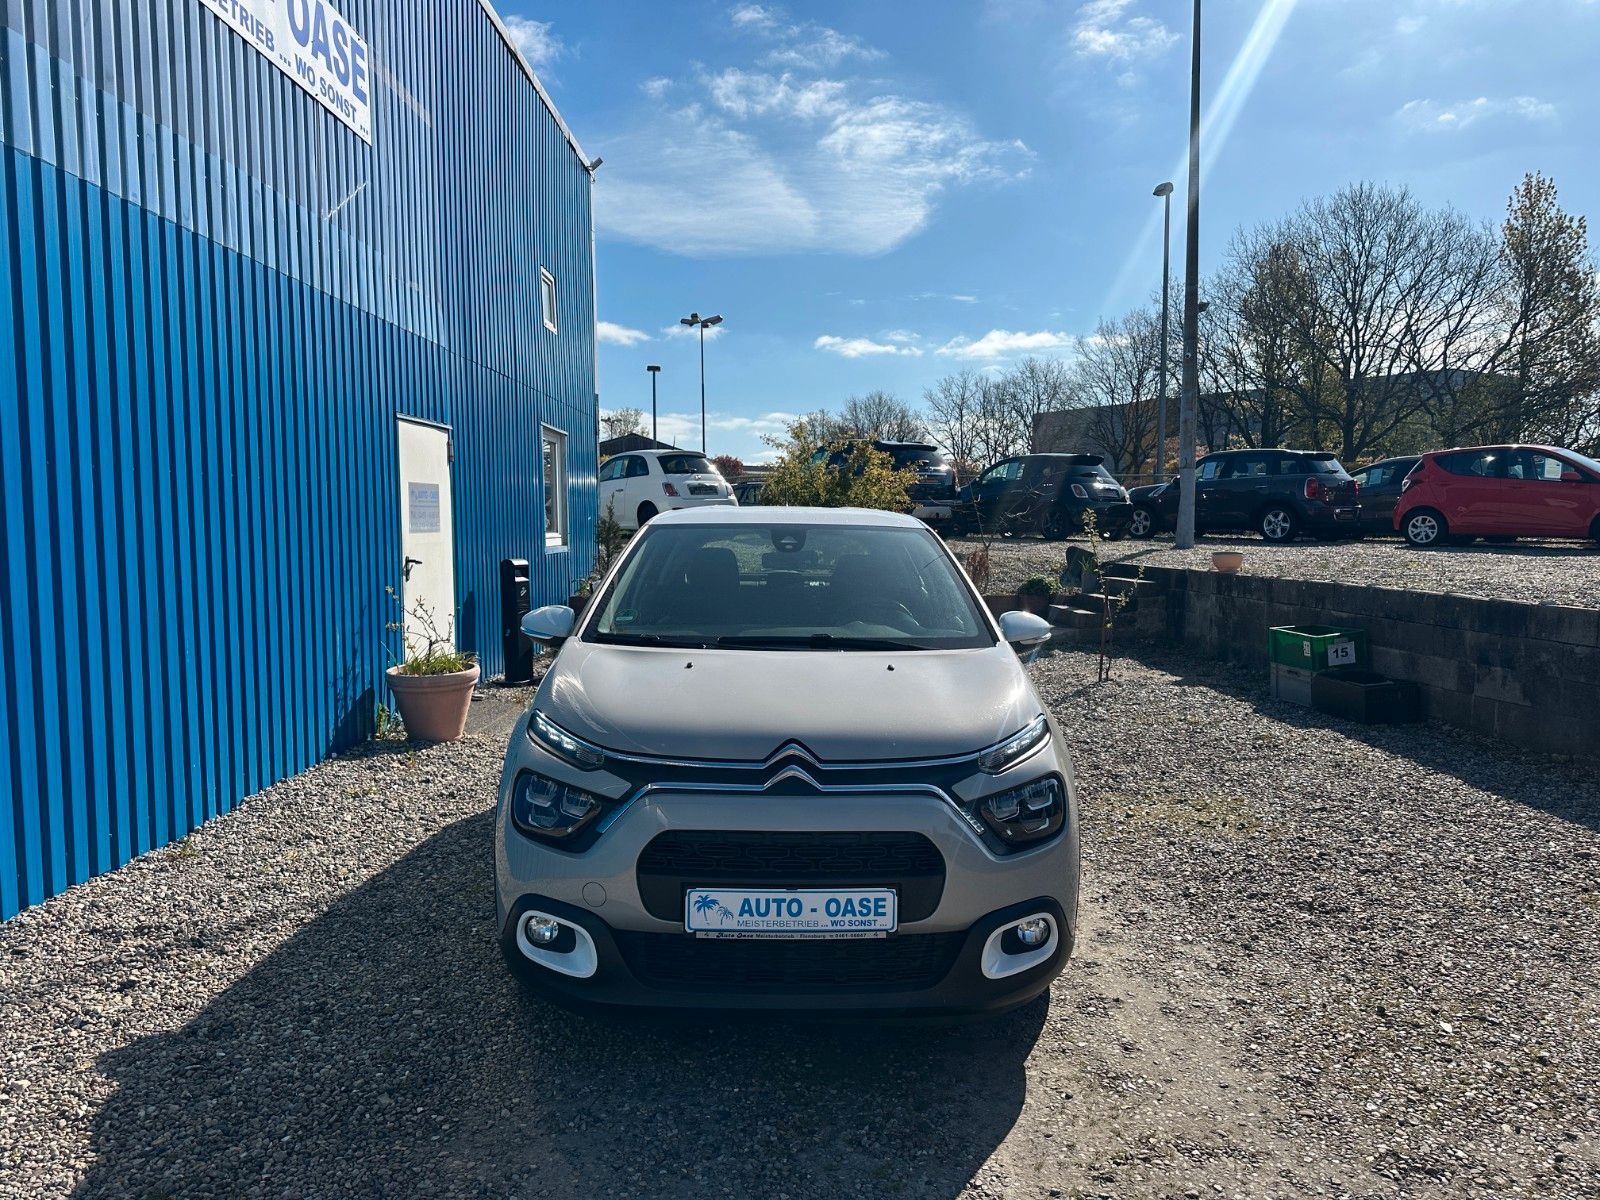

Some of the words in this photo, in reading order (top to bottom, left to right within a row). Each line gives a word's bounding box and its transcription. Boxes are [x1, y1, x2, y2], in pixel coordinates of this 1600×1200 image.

[212, 0, 275, 52] ETRIEB
[294, 53, 316, 87] WO
[319, 77, 358, 124] SONST
[287, 0, 368, 107] OASE
[1333, 646, 1349, 659] 15
[738, 897, 803, 918] AUTO
[825, 897, 887, 918] OASE
[737, 919, 819, 928] MEISTERBETRIEB
[831, 919, 846, 927] WO
[847, 919, 878, 927] SONST
